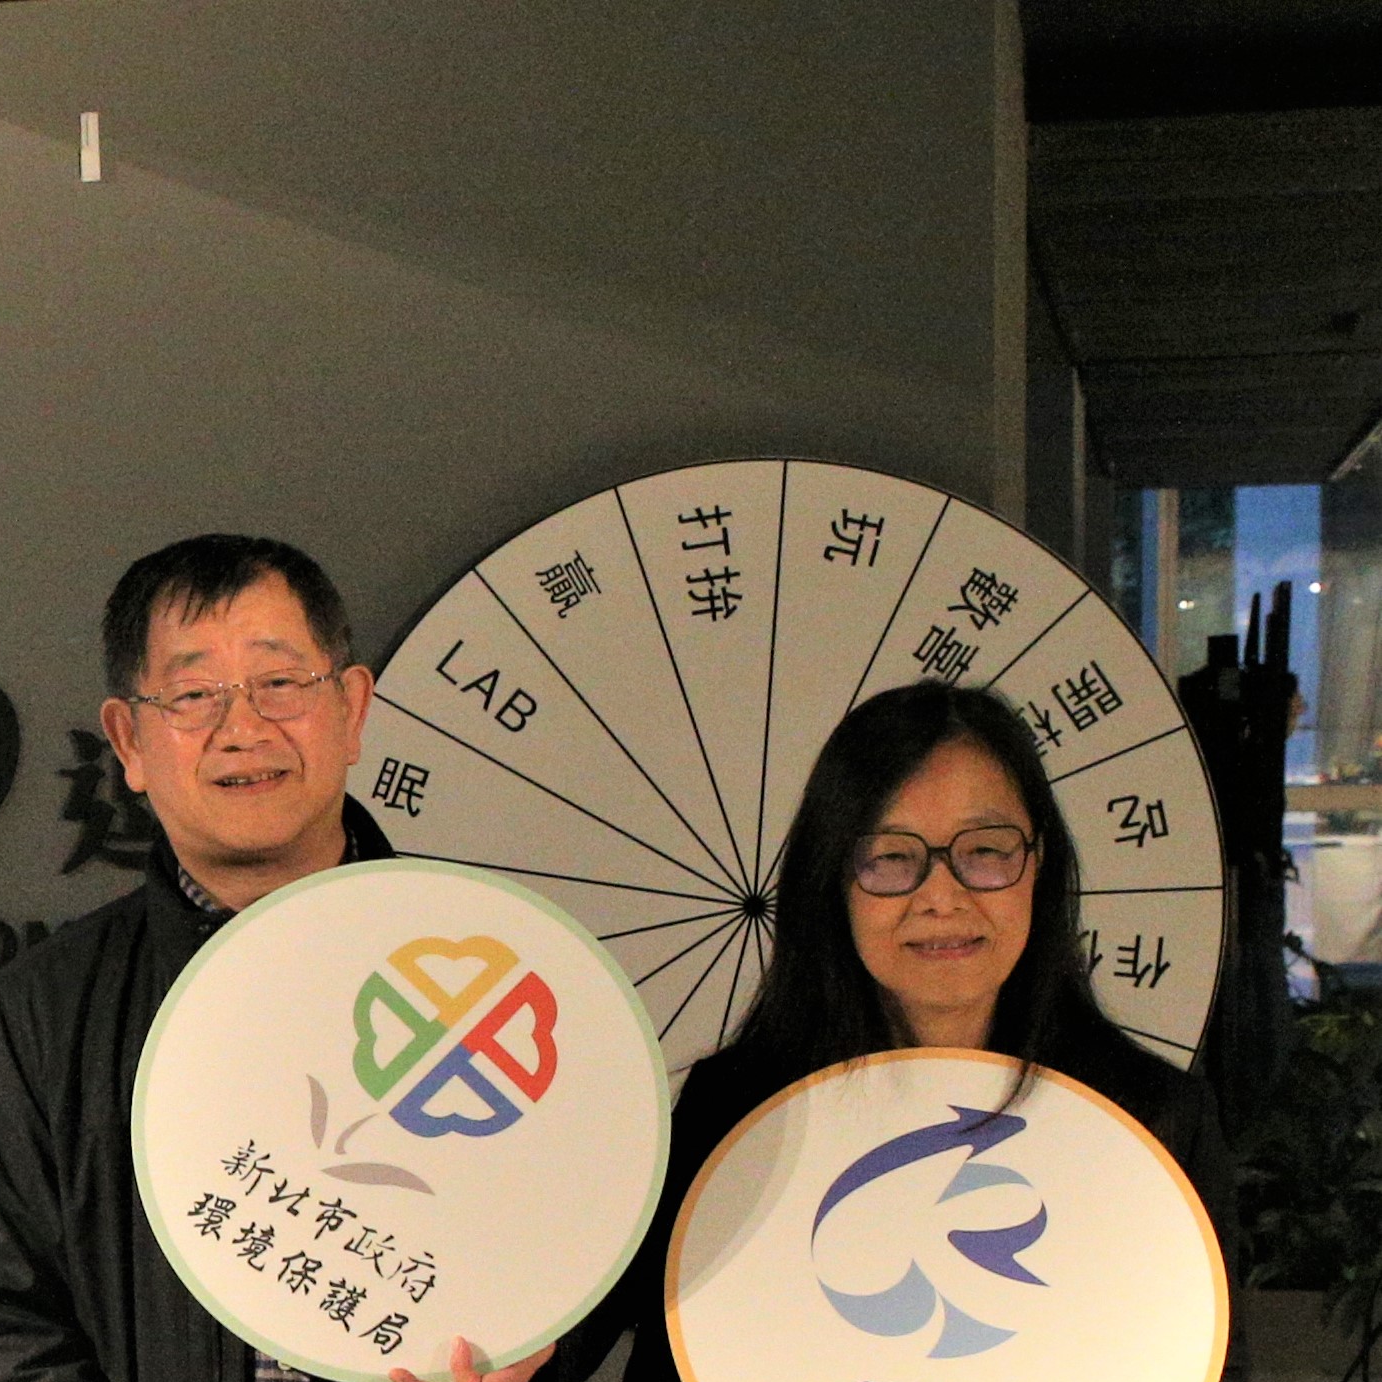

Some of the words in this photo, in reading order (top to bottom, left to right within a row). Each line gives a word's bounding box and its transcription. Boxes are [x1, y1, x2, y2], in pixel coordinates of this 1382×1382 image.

[824, 509, 884, 567] 玩
[535, 550, 601, 619] 贏
[436, 640, 537, 732] LAB
[372, 757, 429, 817] 眠
[1107, 796, 1169, 848] 吃
[221, 1140, 436, 1303] 新北市政府
[187, 1193, 409, 1354] 環境保護局
